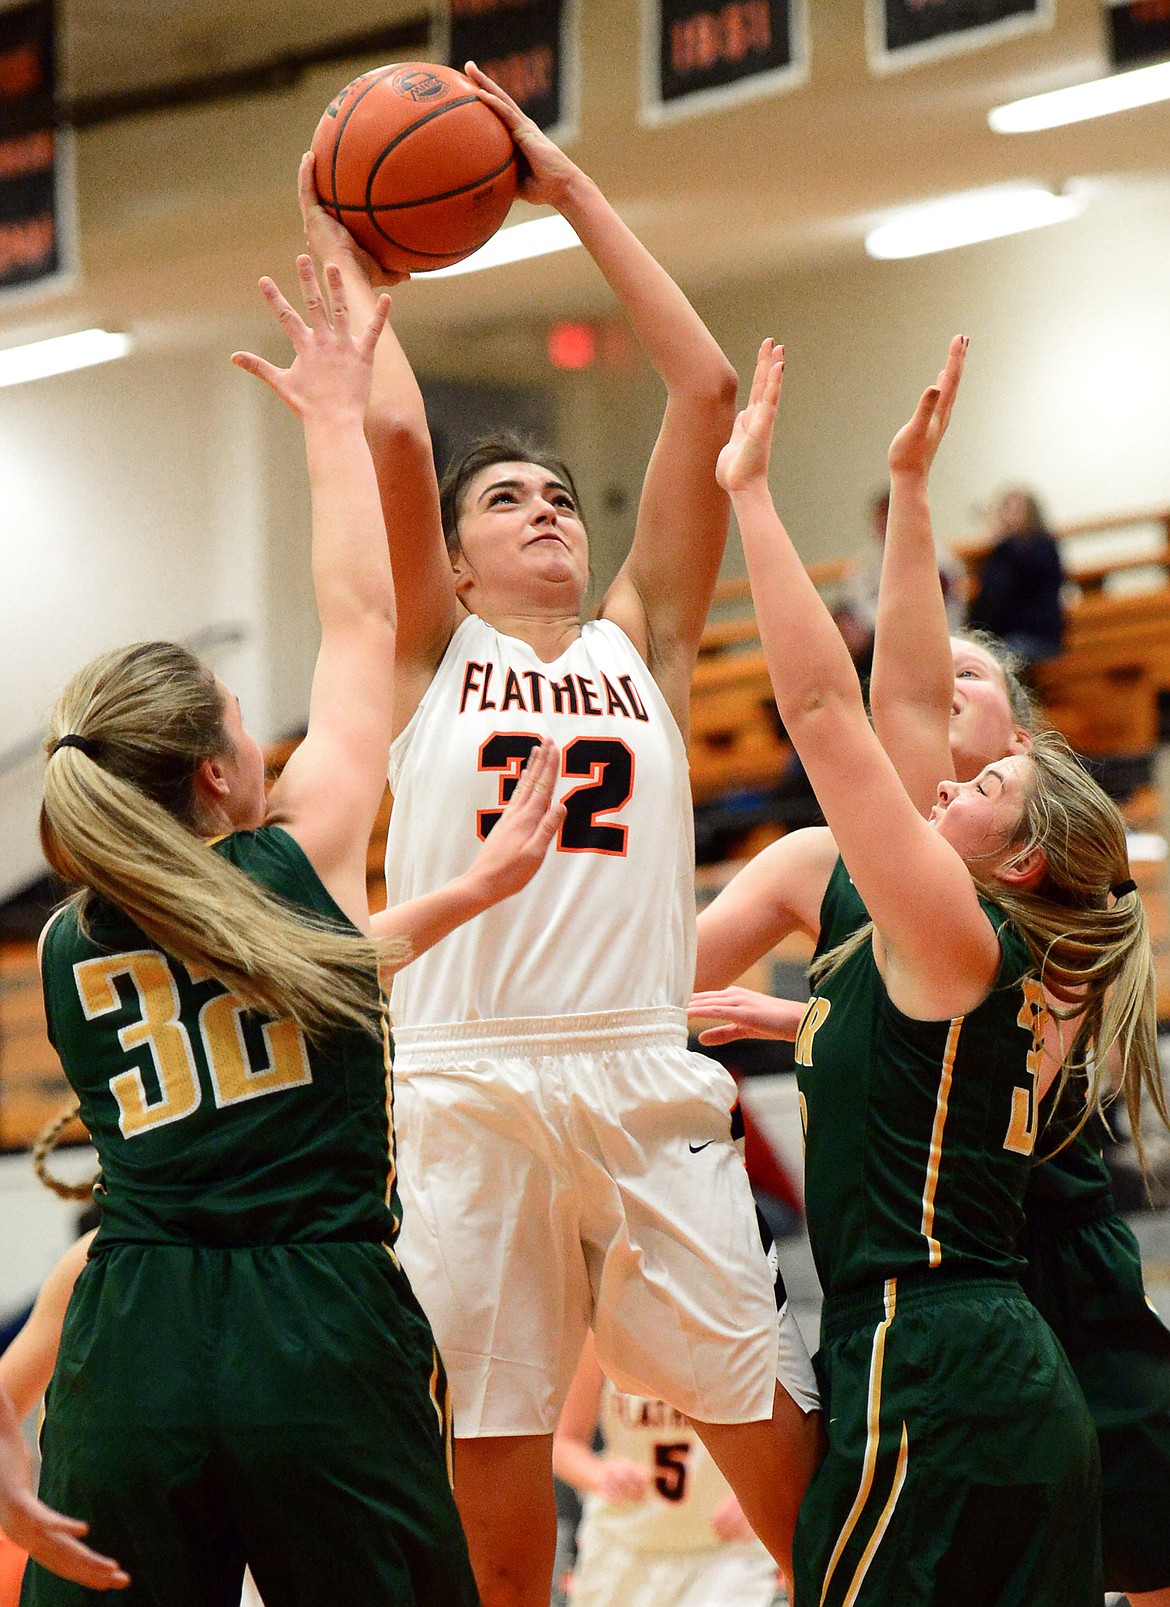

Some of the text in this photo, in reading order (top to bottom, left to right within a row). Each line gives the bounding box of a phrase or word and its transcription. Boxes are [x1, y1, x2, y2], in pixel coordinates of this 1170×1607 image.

[459, 661, 649, 723] FLATHEAD
[477, 731, 635, 857] 32
[73, 950, 313, 1140] 32
[654, 1440, 691, 1504] 5
